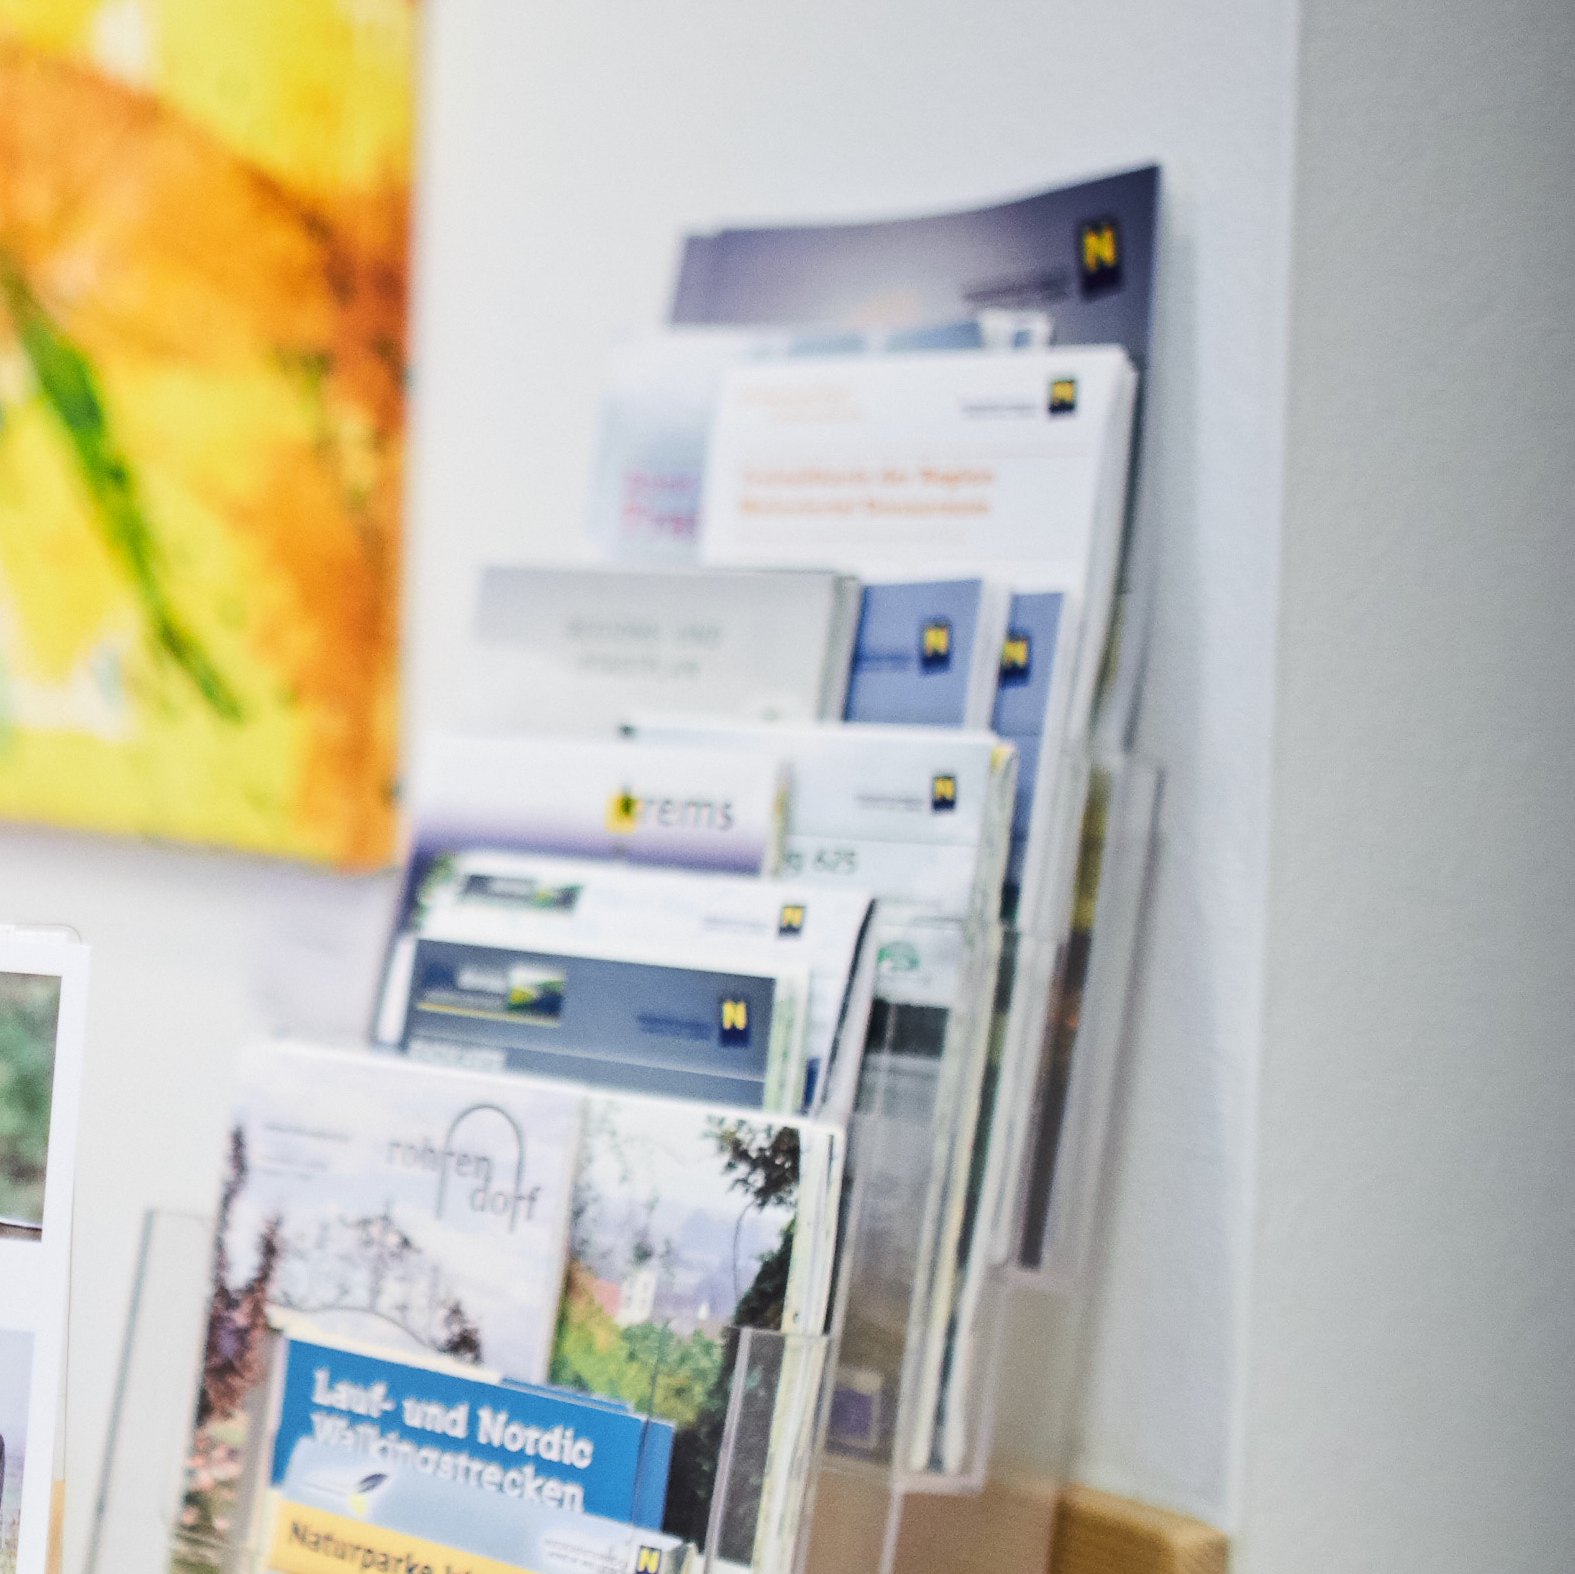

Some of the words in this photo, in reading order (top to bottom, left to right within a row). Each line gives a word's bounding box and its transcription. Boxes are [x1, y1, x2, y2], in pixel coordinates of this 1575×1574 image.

[311, 1365, 397, 1419] Lauf-
[401, 1396, 470, 1440] und
[476, 1404, 595, 1471] Nordic
